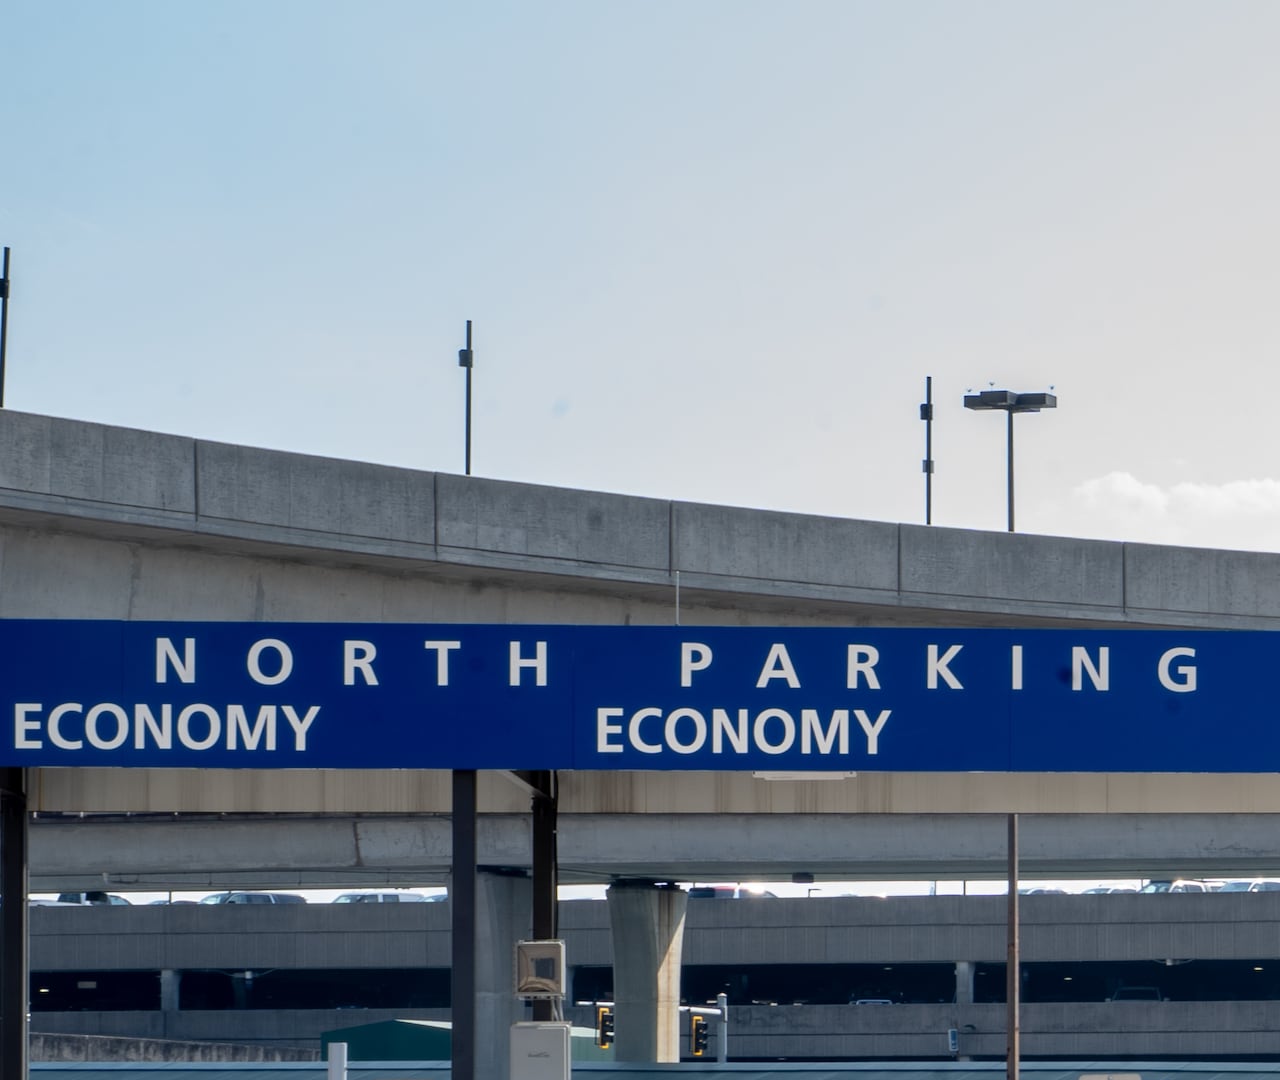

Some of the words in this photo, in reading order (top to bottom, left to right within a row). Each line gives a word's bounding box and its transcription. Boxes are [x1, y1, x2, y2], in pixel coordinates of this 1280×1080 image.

[155, 637, 548, 686] NORTH
[681, 642, 1198, 693] PARKING
[14, 702, 321, 751] ECONOMY
[597, 707, 892, 755] ECONOMY
